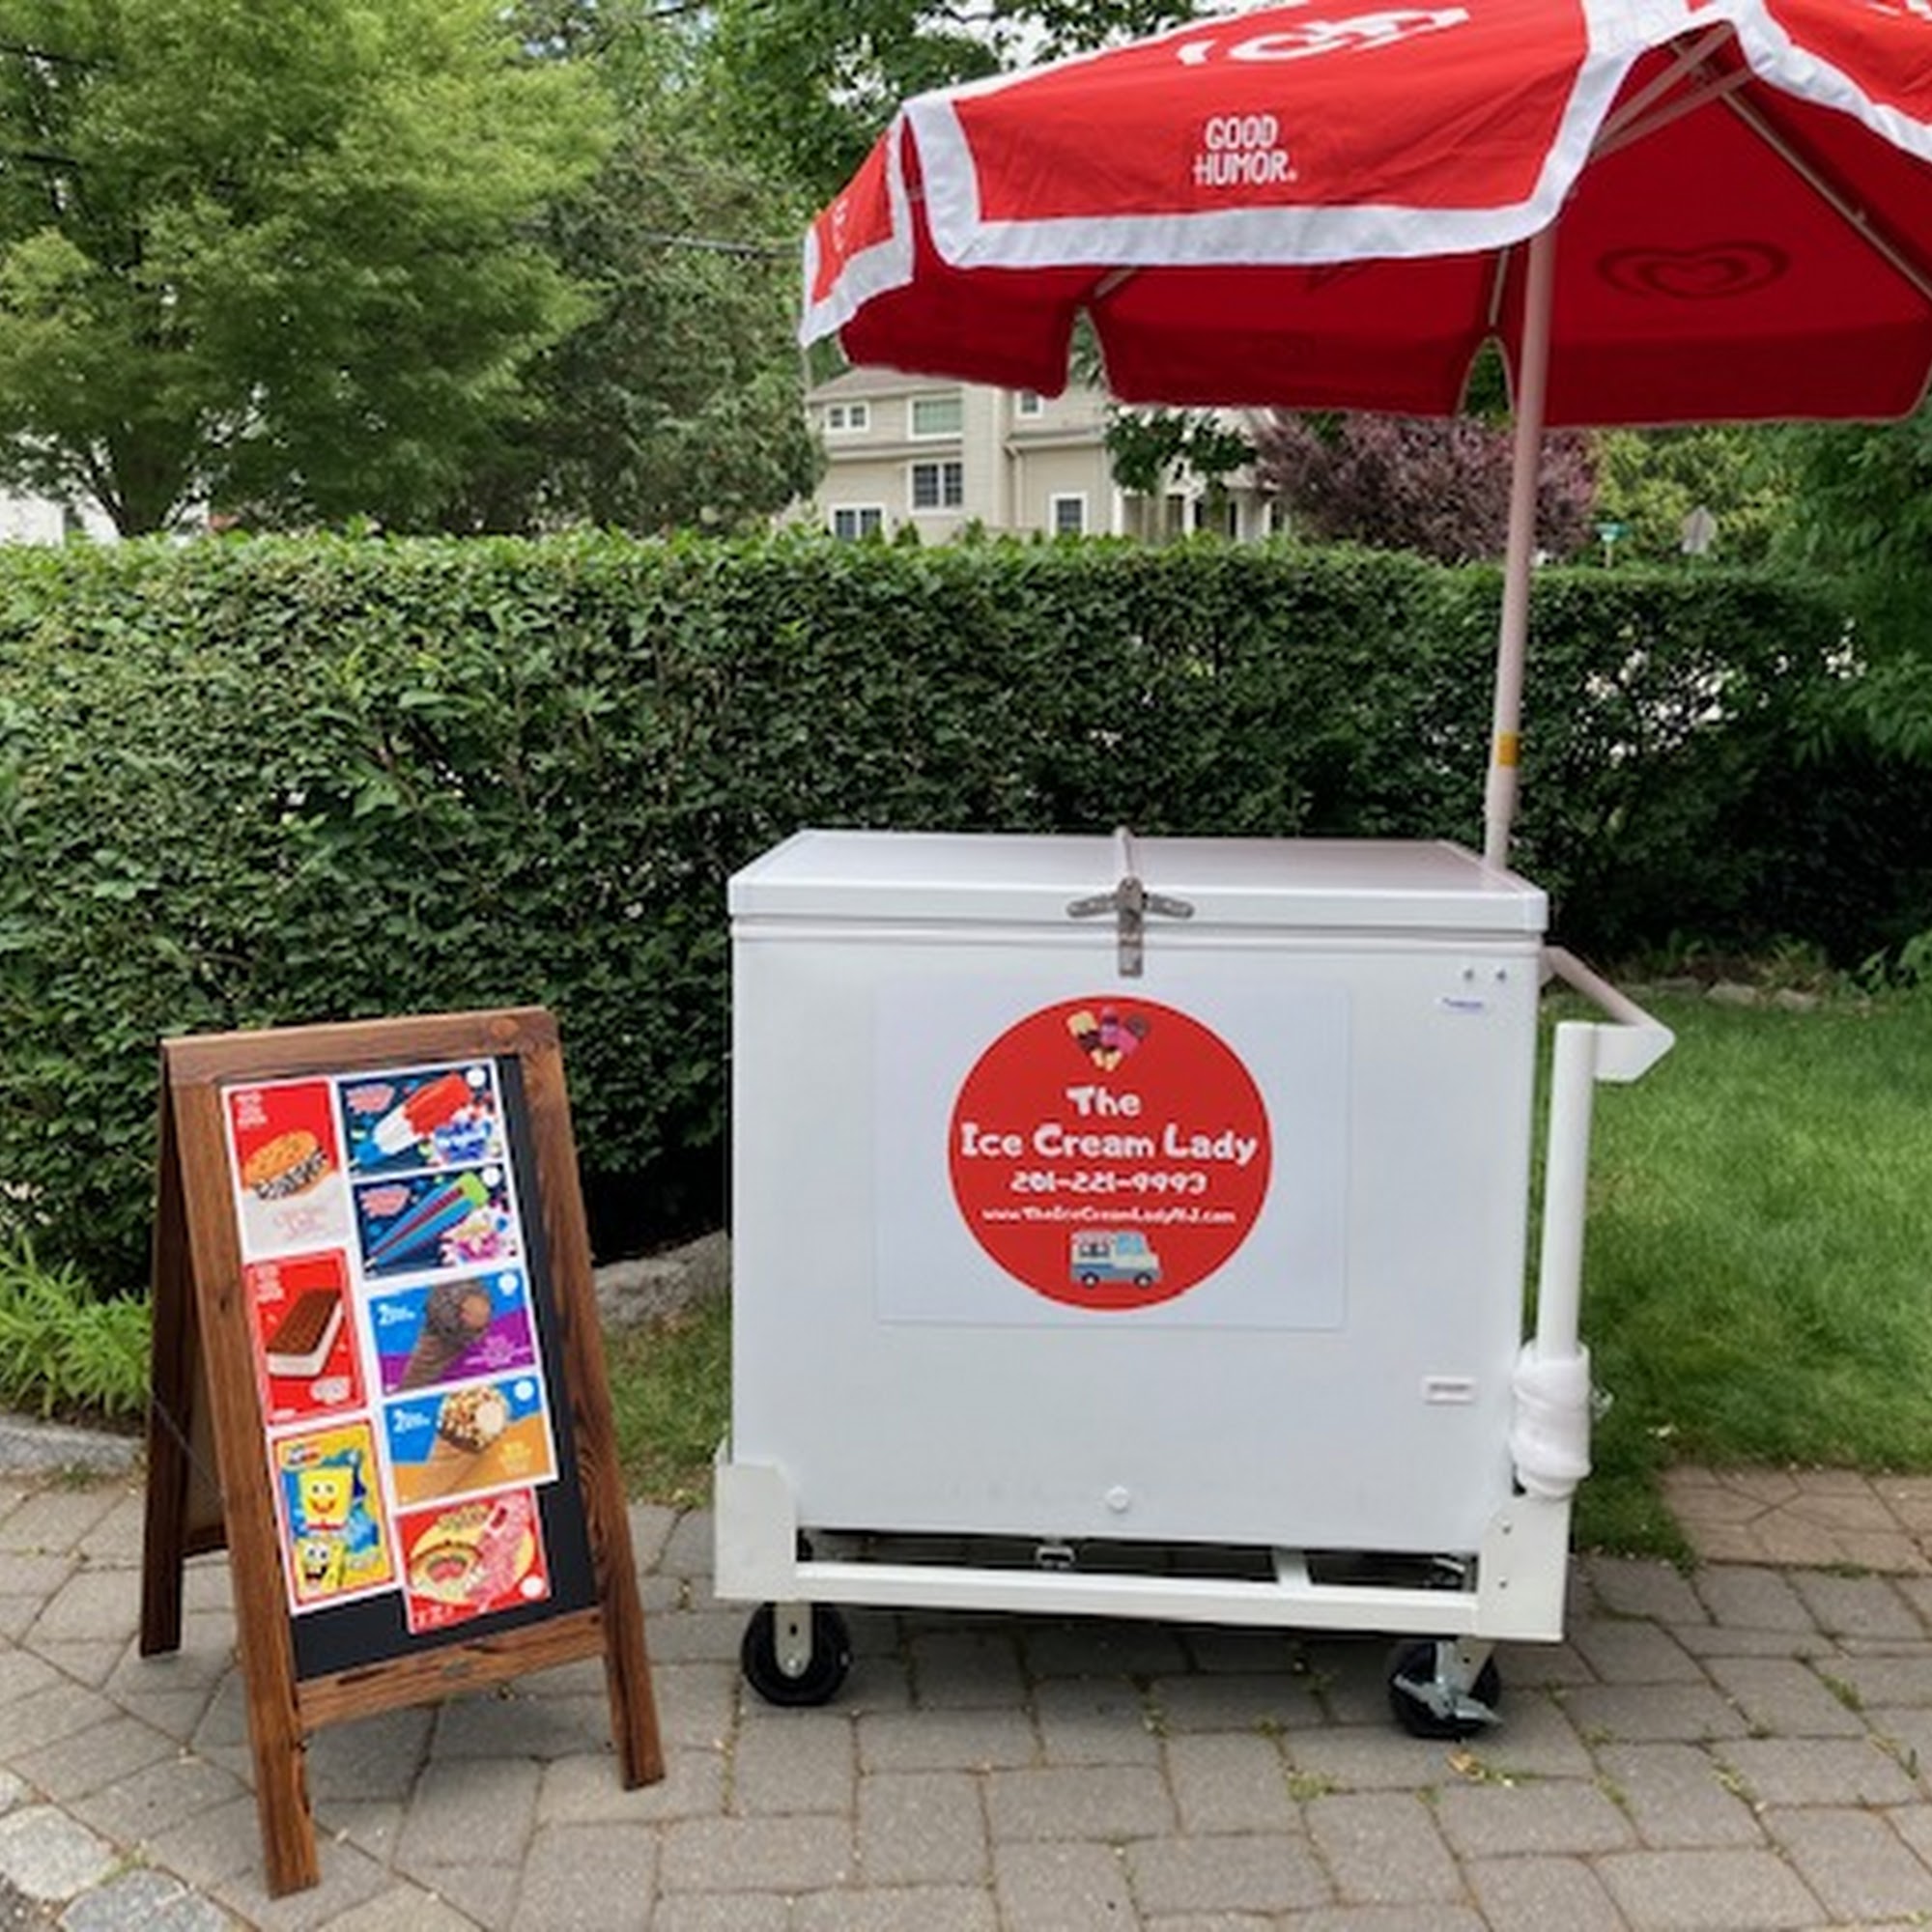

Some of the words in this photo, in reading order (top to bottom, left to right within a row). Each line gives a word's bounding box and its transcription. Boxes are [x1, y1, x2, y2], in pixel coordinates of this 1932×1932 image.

[1205, 114, 1279, 151] GOOD
[1066, 1085, 1141, 1117] The
[961, 1122, 1023, 1157] Ice
[1033, 1122, 1155, 1158] Cream
[1164, 1123, 1257, 1165] Lady
[1010, 1170, 1208, 1195] 201-221-9993
